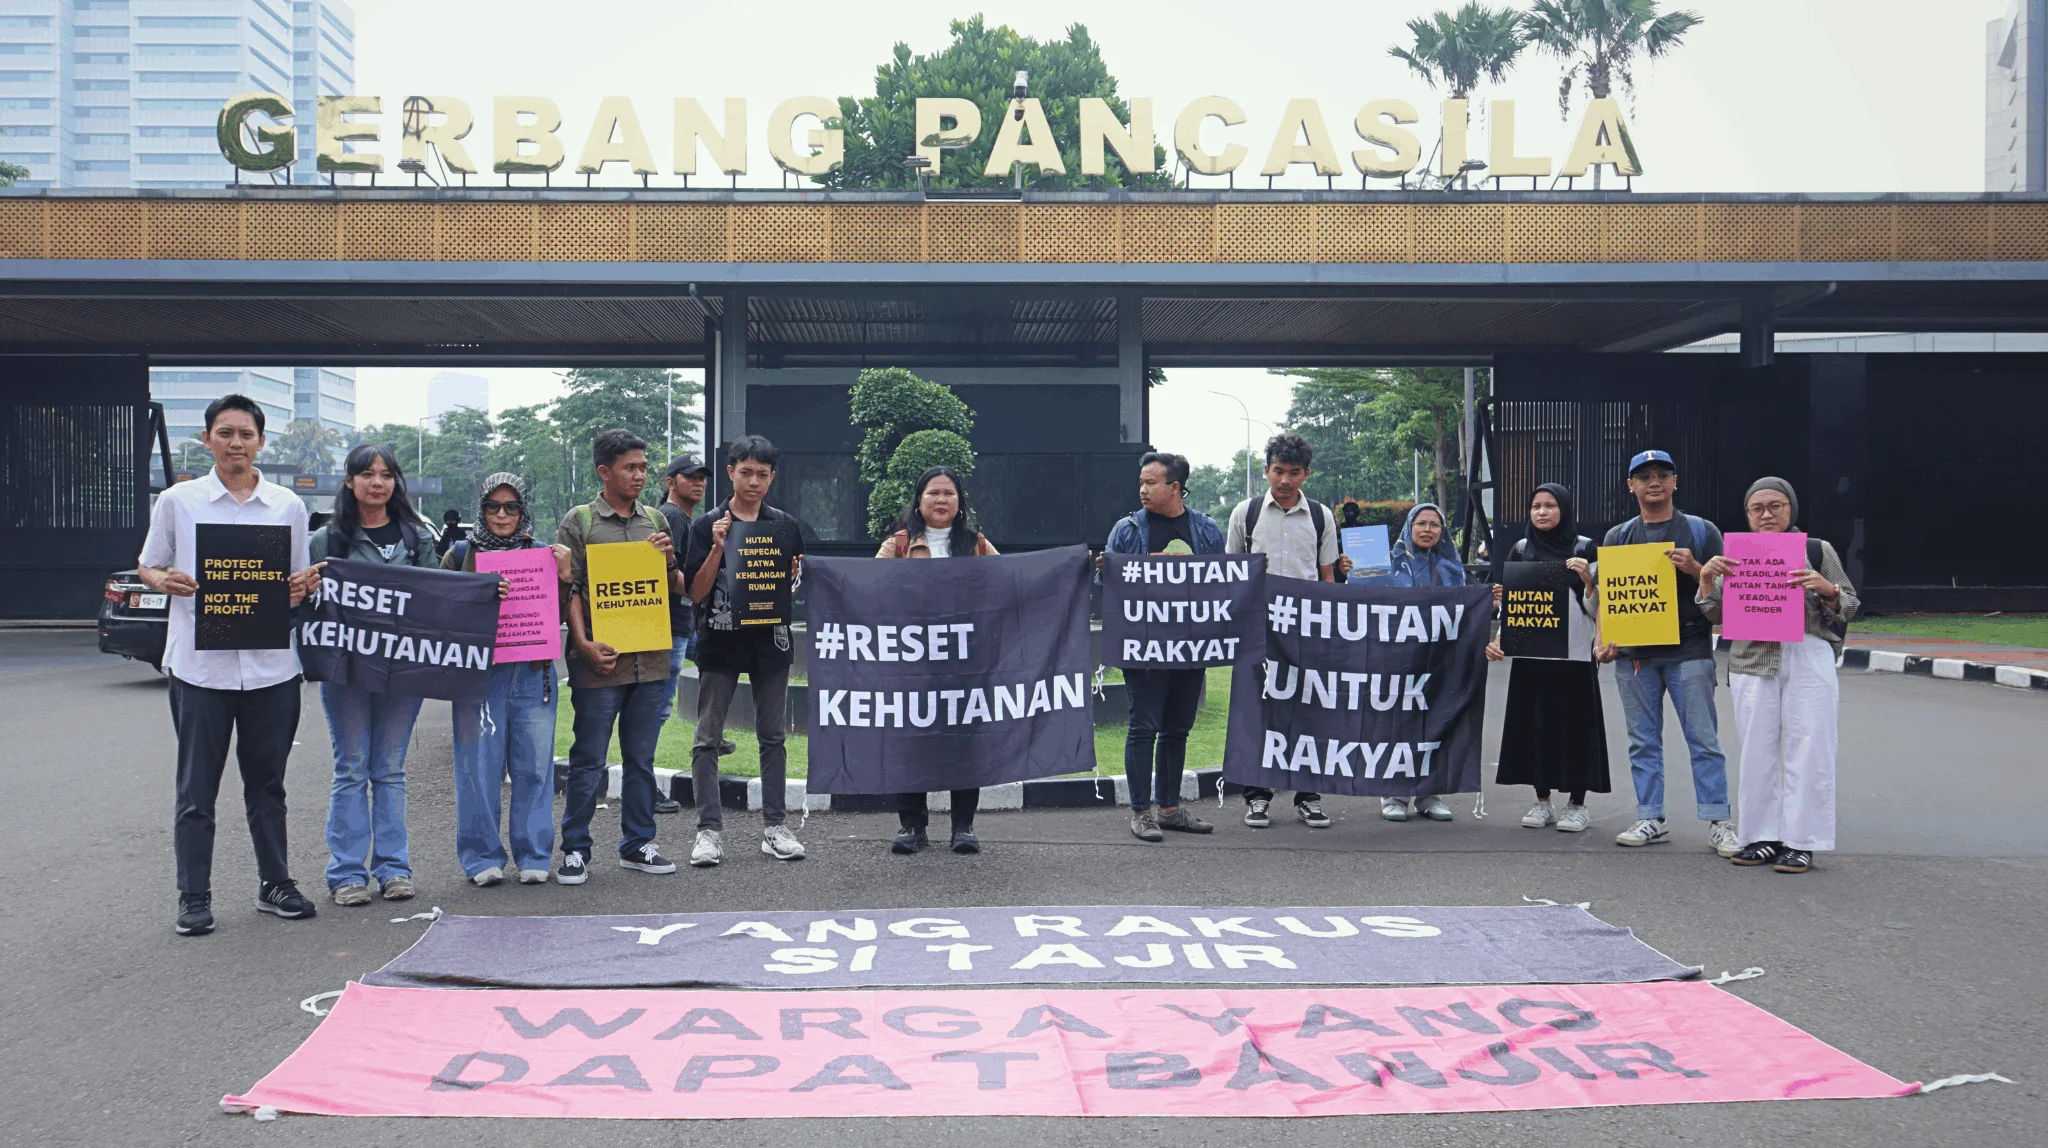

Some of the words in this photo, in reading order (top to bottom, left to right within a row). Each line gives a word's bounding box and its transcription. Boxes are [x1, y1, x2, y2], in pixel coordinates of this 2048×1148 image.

[216, 91, 845, 176] GERBANG
[915, 96, 1645, 178] PANCASILA
[1643, 450, 1656, 460] T
[745, 536, 773, 544] HUTAN
[738, 548, 782, 556] TERPECAH,
[204, 559, 264, 569] PROTECT
[747, 560, 775, 568] SATWA
[1765, 558, 1785, 566] ADA
[205, 570, 230, 580] THE
[233, 570, 284, 582] FOREST,
[499, 567, 544, 576] PEREMPUAN
[735, 571, 786, 580] KEHILANGAN
[1122, 560, 1250, 584] #HUTAN
[748, 583, 776, 591] RUMAH
[1606, 574, 1658, 588] HUTAN
[1764, 582, 1797, 590] TANPA
[596, 579, 659, 598] RESET
[1607, 588, 1660, 601] UNTUK
[204, 593, 231, 603] NOT
[235, 593, 259, 603] THE
[1508, 590, 1554, 602] HUTAN
[1739, 593, 1787, 602] KEADILAN
[204, 605, 255, 615] PROFIT.
[596, 597, 663, 610] KEHUTANAN
[1507, 603, 1554, 615] UNTUK
[1607, 601, 1667, 615] RAKYAT
[1123, 599, 1233, 623] UNTUK
[1268, 594, 1465, 643] #HUTAN
[1507, 616, 1560, 628] RAKYAT
[302, 621, 490, 671] KEHUTANAN
[815, 622, 975, 662] #RESET
[1123, 637, 1240, 662] RAKYAT
[1267, 659, 1432, 712] UNTUK
[818, 672, 1085, 728] KEHUTANAN
[1262, 729, 1442, 779] RAKYAT
[610, 917, 971, 946] YANG
[1012, 914, 1442, 938] RAKUS
[763, 945, 878, 975] SI
[925, 943, 1298, 969] TAJIR
[493, 1003, 1113, 1042] WARGA
[424, 1050, 1039, 1094] DAPAT
[1105, 1040, 1710, 1091] BANJIR
